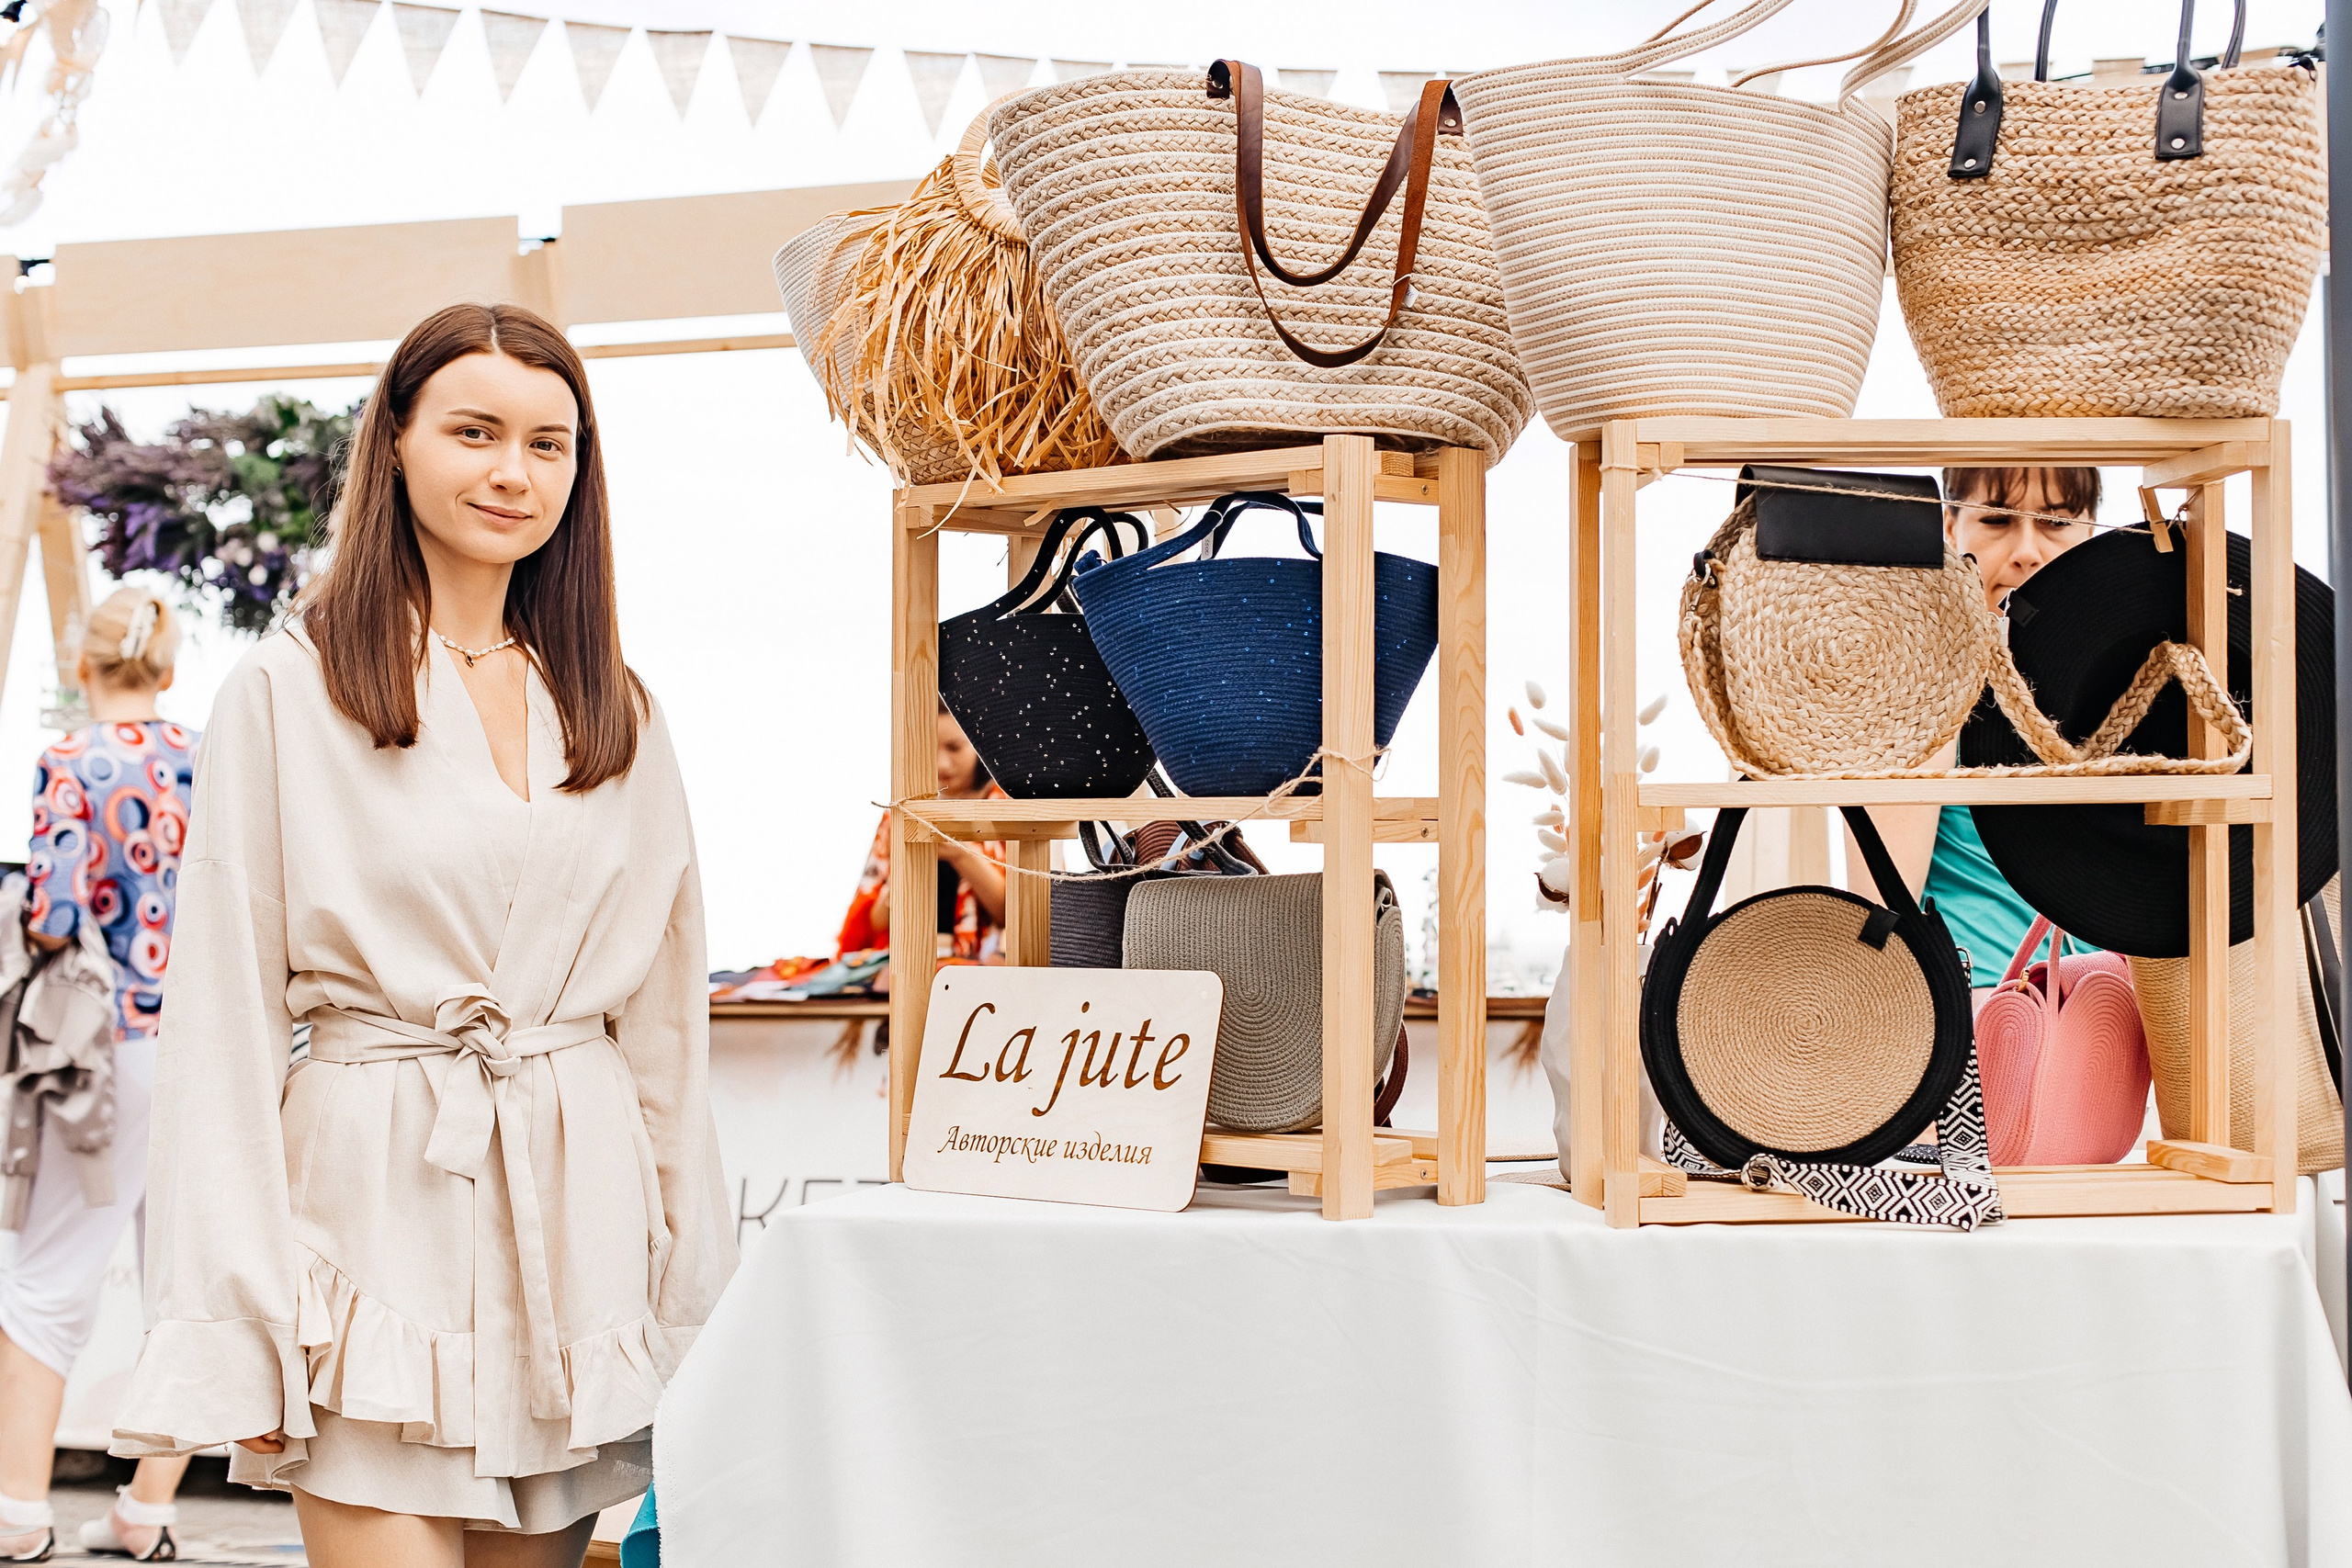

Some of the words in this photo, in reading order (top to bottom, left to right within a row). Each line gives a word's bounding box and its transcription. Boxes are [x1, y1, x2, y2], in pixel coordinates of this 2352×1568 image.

[939, 1002, 1037, 1083] La
[1031, 1000, 1191, 1117] jute
[937, 1125, 1057, 1164] Авторские
[1064, 1131, 1152, 1165] изделия
